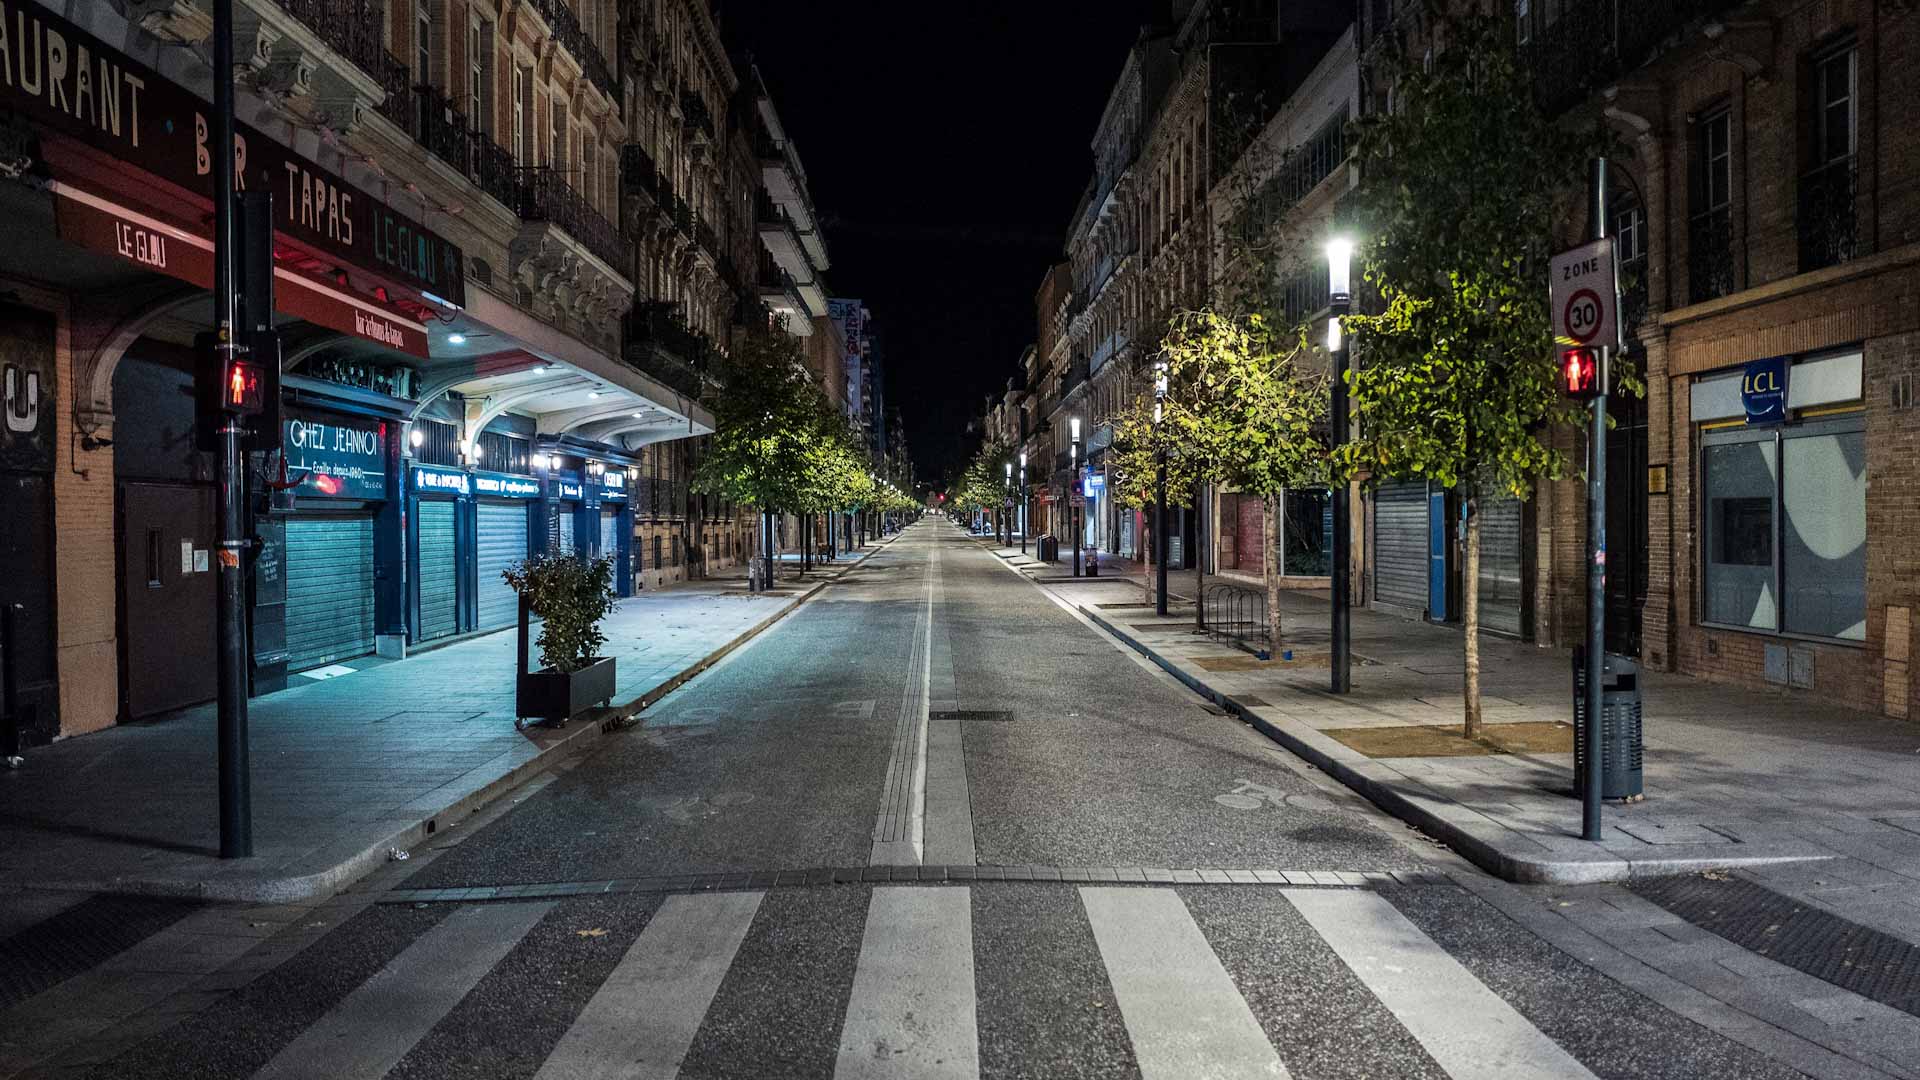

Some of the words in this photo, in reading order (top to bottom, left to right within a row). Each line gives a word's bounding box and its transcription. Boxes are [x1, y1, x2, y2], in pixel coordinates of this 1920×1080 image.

[196, 112, 246, 191] BR
[285, 161, 352, 245] TAPAS
[116, 221, 133, 258] LE
[136, 231, 166, 268] GLOU
[374, 209, 394, 265] LE
[398, 226, 436, 285] GLOU
[1563, 257, 1599, 280] ZONE
[1572, 303, 1595, 329] 30
[1744, 371, 1780, 394] LCL
[290, 419, 325, 450] CHEZ
[333, 426, 377, 455] JEANNOT
